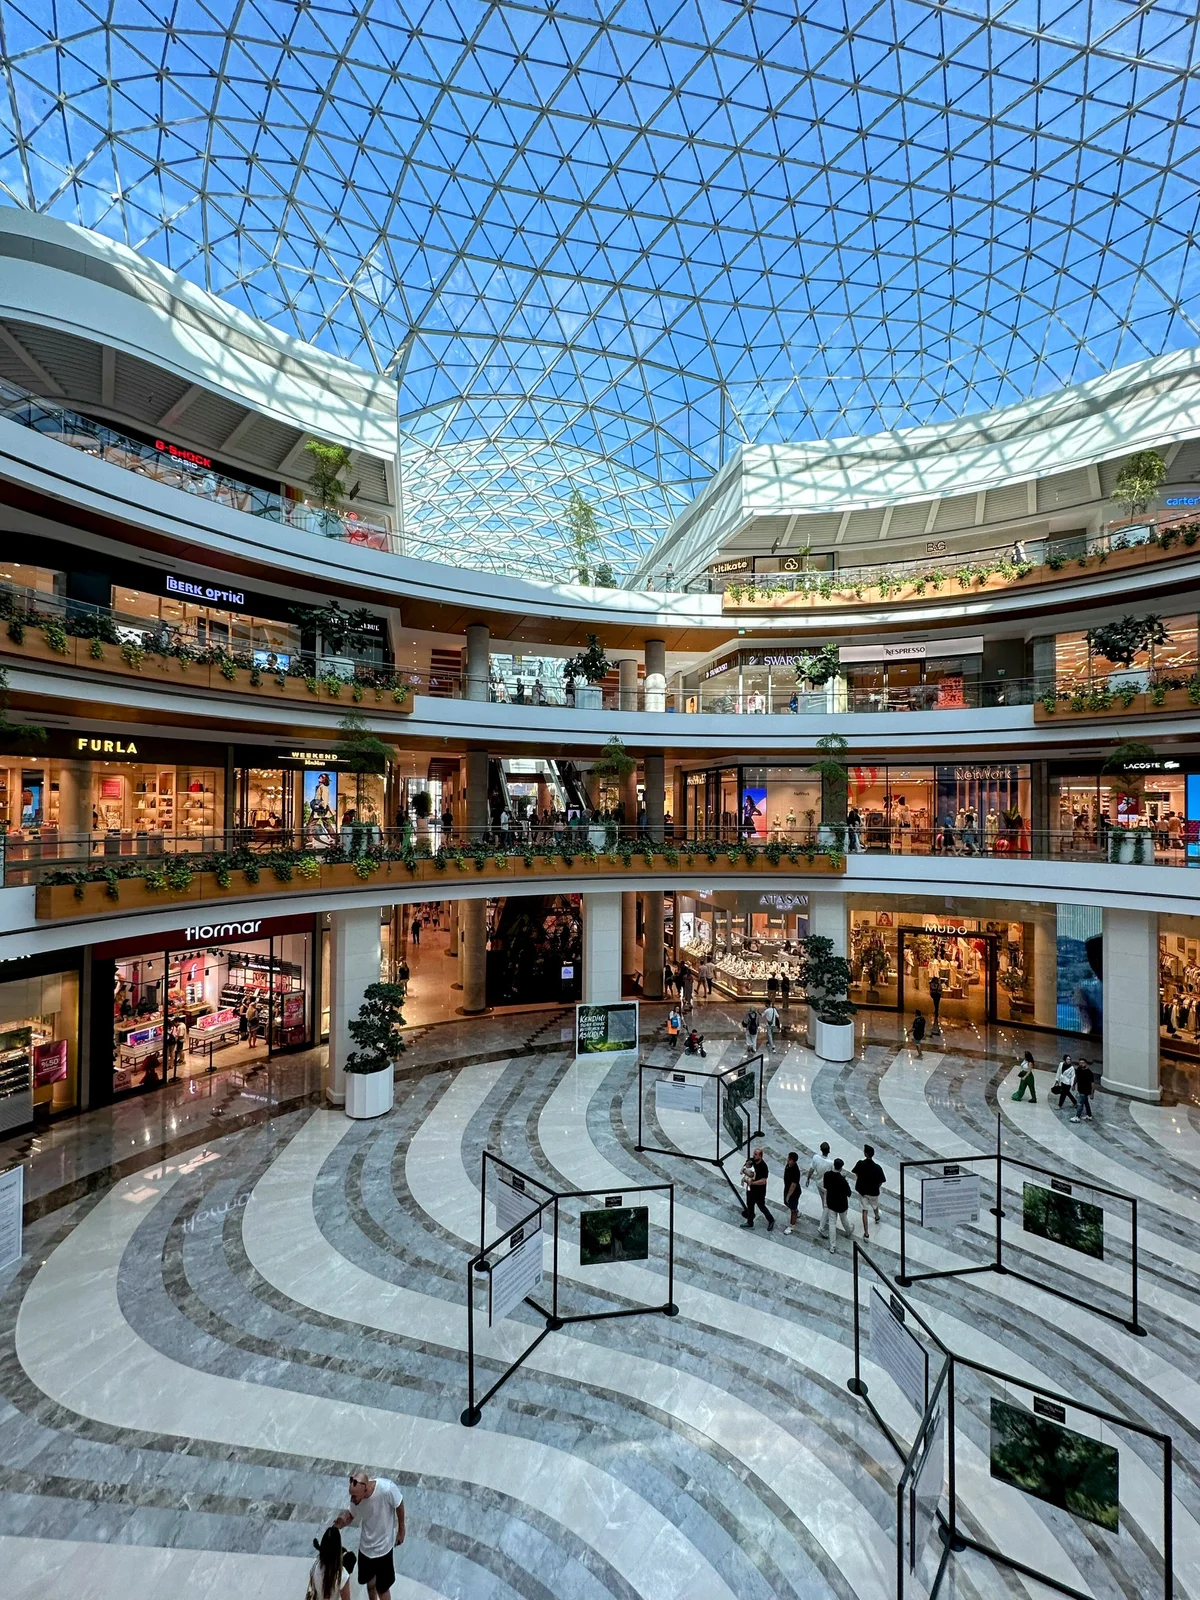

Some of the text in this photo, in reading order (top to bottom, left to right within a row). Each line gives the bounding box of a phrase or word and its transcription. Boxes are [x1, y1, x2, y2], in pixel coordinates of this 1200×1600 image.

[155, 439, 212, 468] G-SHOCK
[171, 455, 198, 469] CASIO
[713, 561, 748, 574] kitikate
[169, 579, 242, 604] BERK OPTİK
[884, 646, 926, 656] NESPRESSO
[78, 738, 138, 754] FURLA
[291, 751, 338, 760] WEEKEND
[1123, 762, 1161, 770] LACOSTE
[954, 767, 1012, 781] NetWork
[759, 895, 809, 905] ATASAY
[925, 923, 968, 935] MUDO
